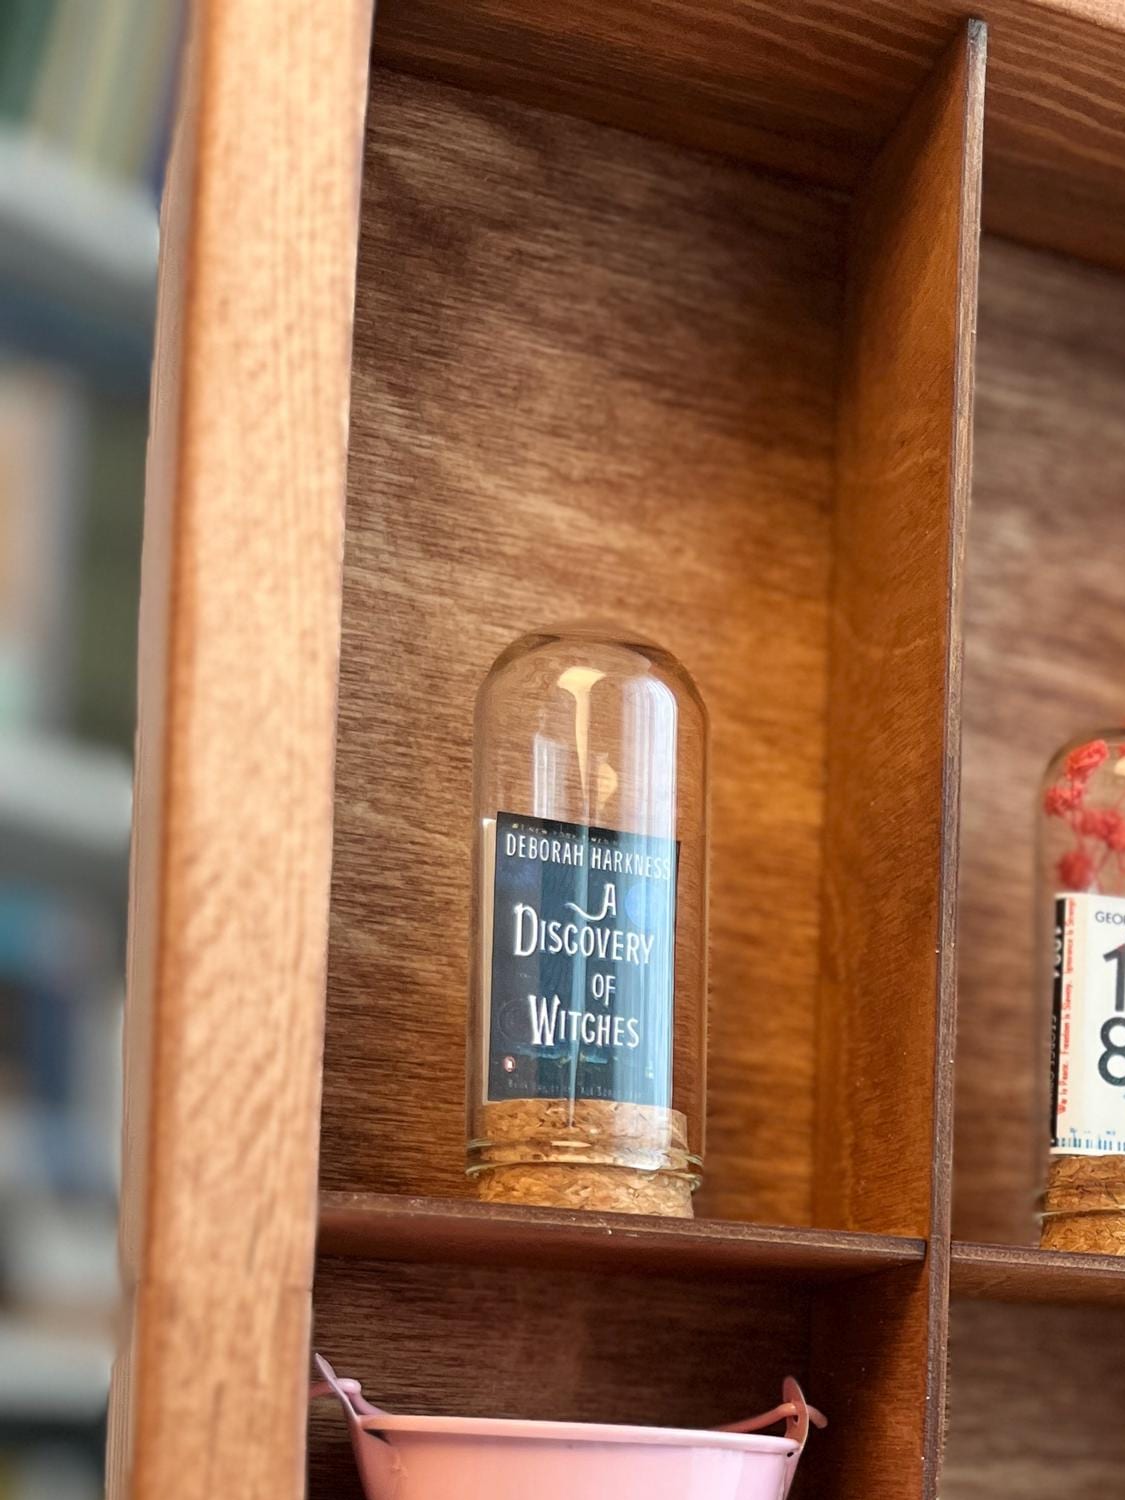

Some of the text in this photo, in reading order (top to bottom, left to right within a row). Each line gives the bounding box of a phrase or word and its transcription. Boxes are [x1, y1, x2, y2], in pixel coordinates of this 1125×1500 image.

[506, 833, 584, 867] DEBORAH
[591, 848, 671, 881] HARKNESS
[592, 973, 616, 1007] OF
[528, 994, 641, 1049] WITCHES
